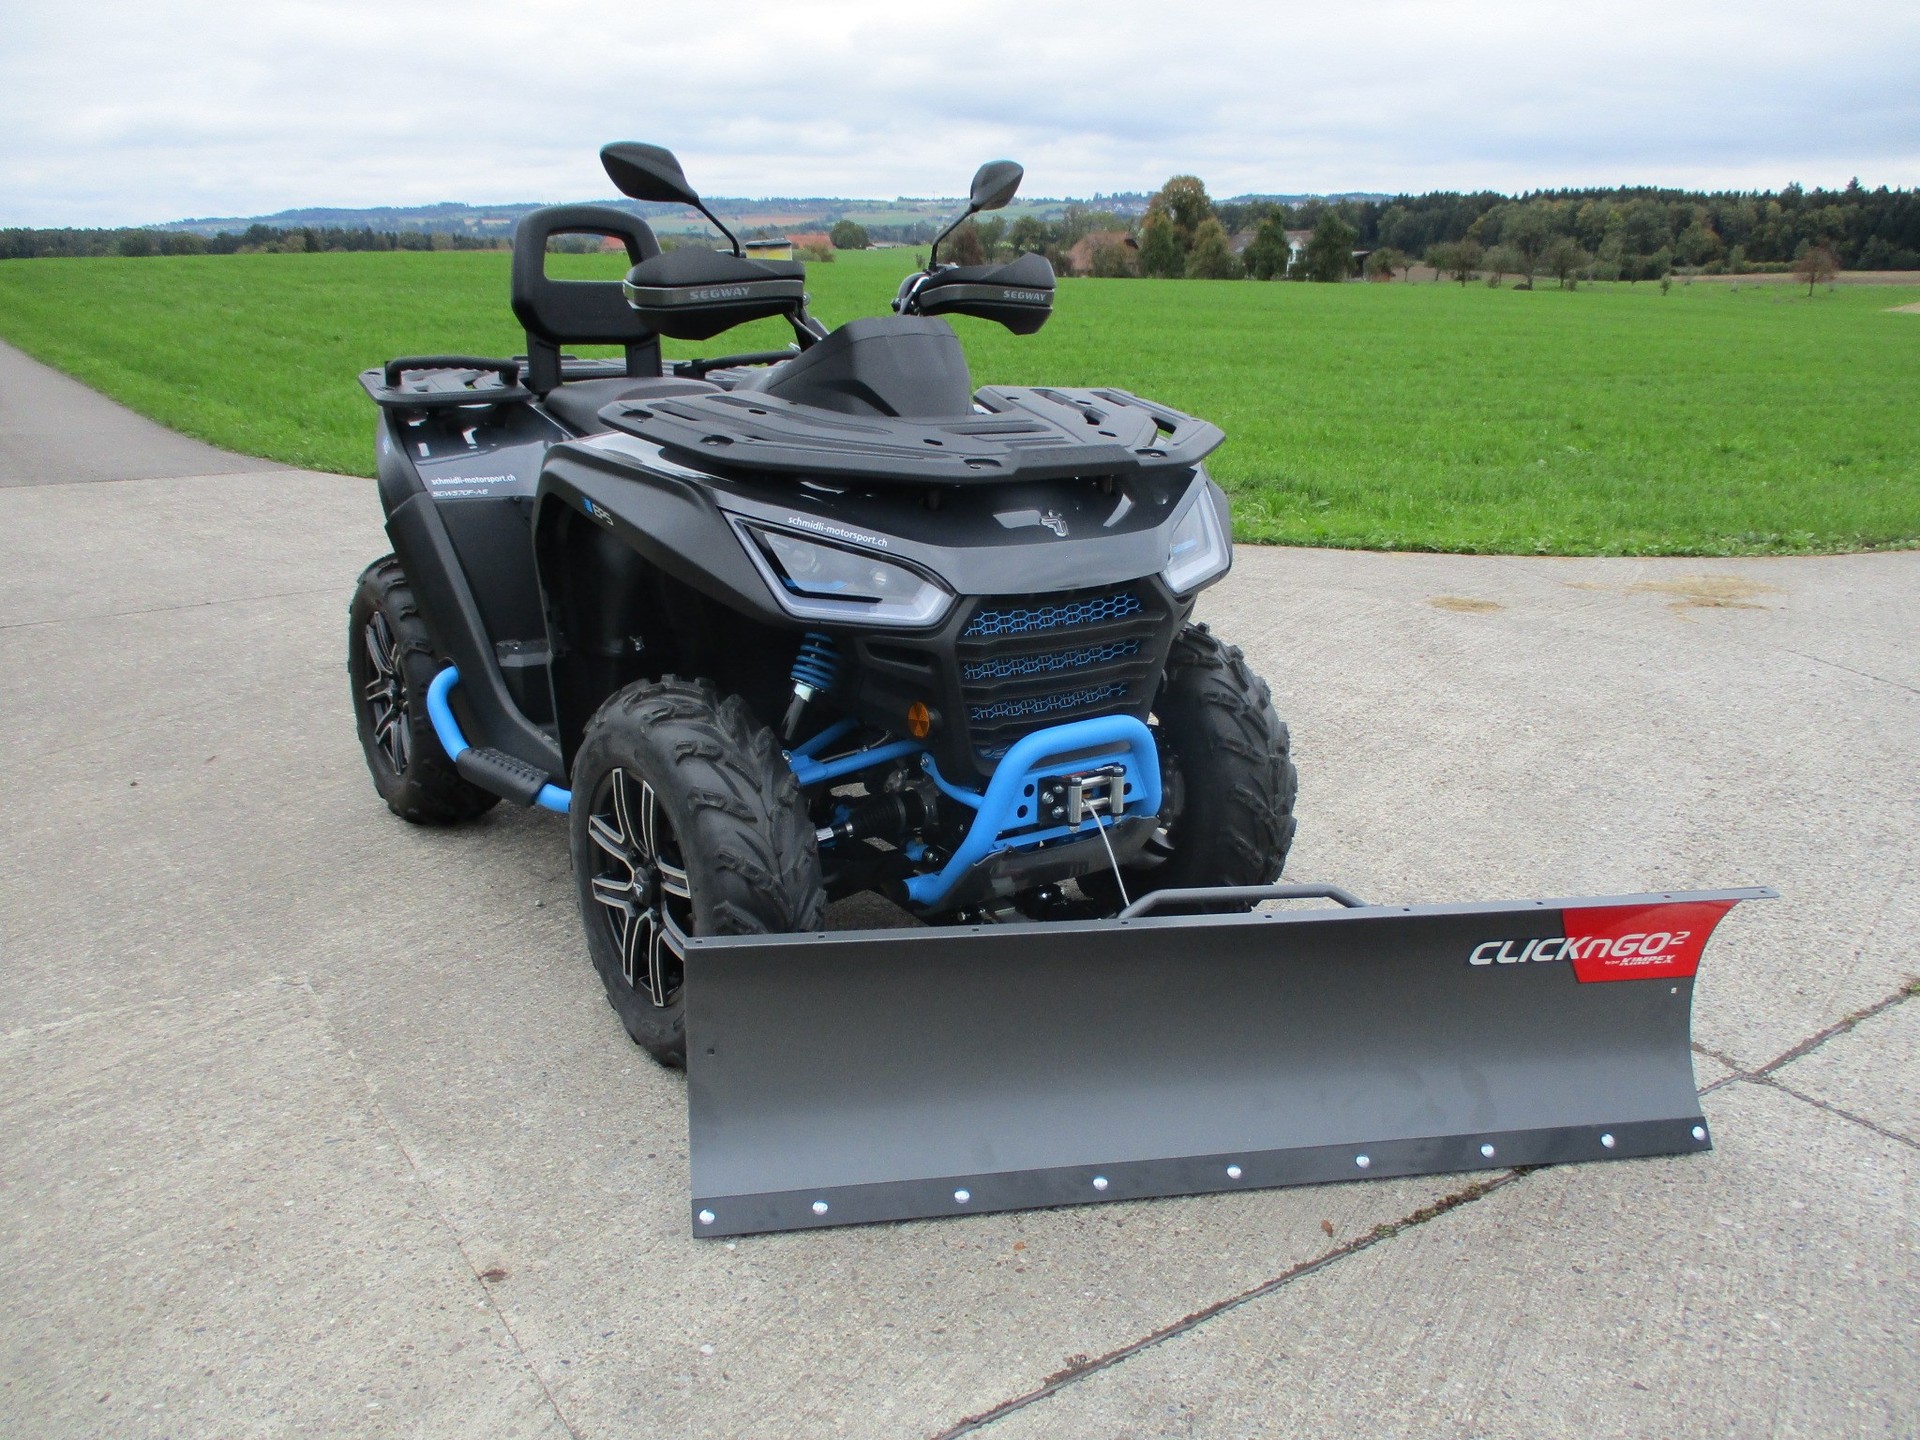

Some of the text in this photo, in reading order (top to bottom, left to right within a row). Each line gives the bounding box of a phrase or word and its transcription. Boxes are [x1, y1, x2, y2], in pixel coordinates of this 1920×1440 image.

[689, 287, 750, 300] SEGWAY
[1003, 290, 1047, 301] SEGWAY
[431, 474, 517, 485] schmidli-motorsport.ch
[788, 516, 888, 548] schmidli-motorsport.ch
[1619, 954, 1676, 966] KIMPEX
